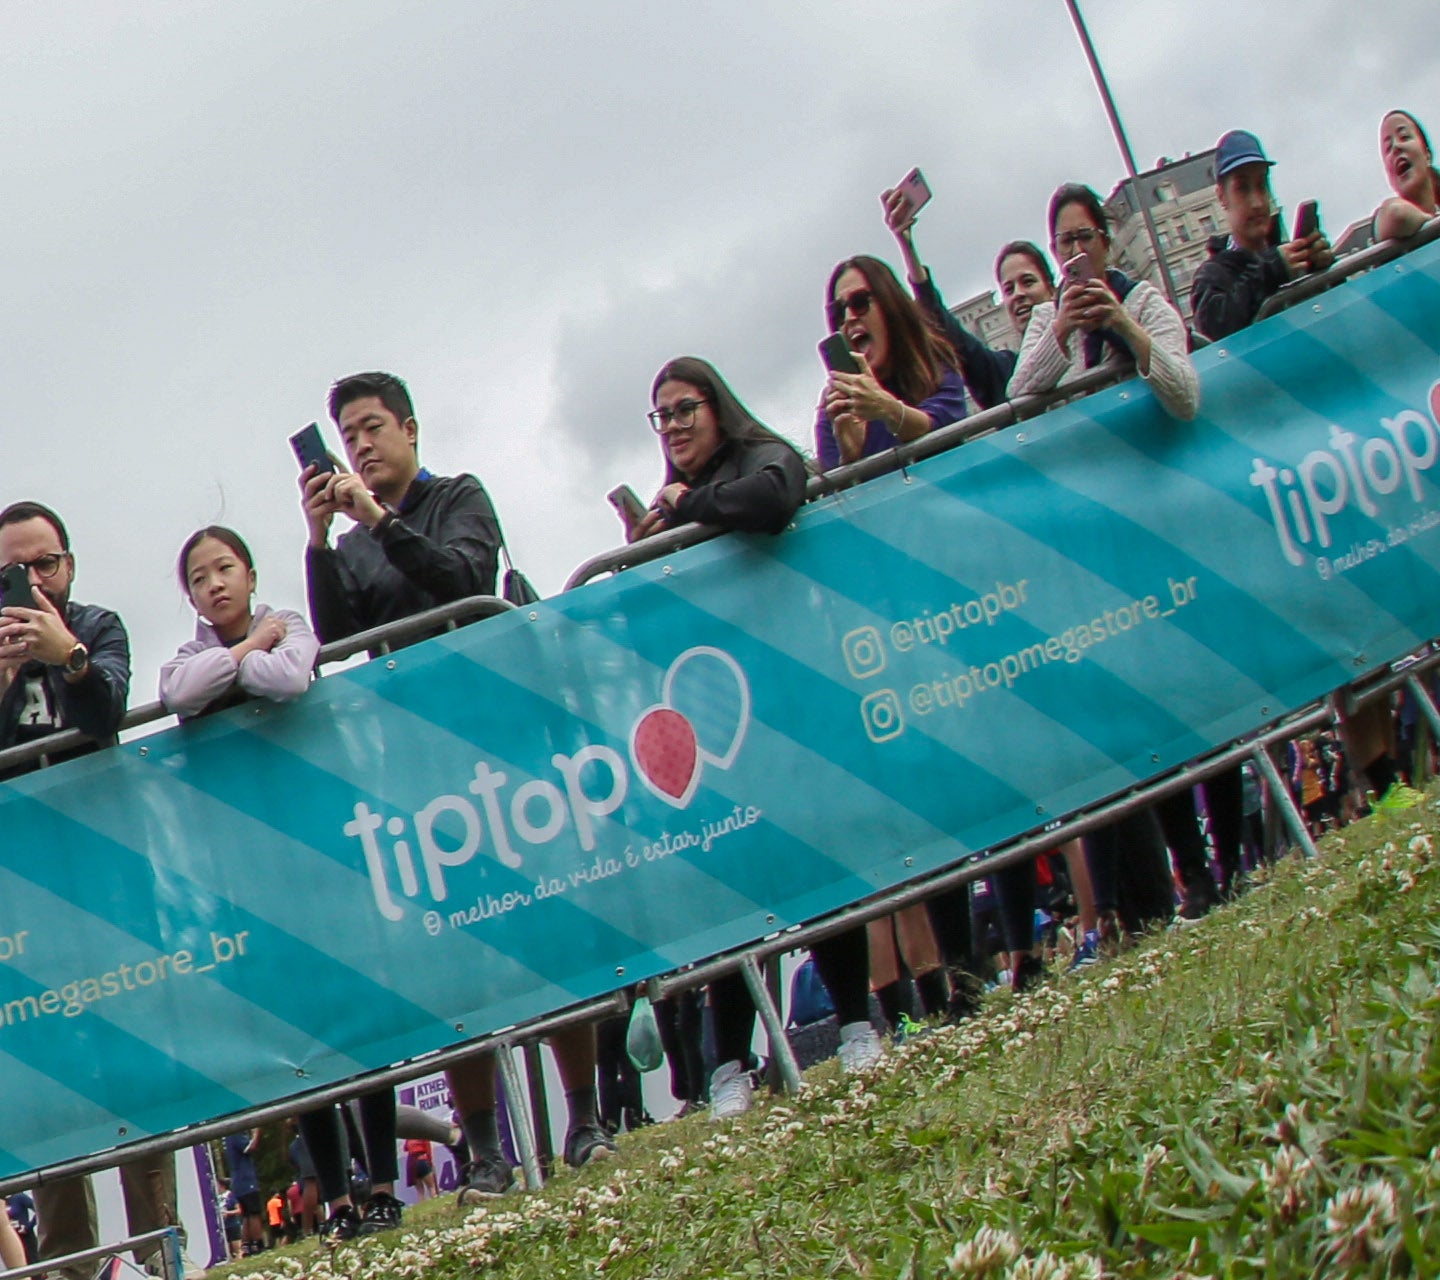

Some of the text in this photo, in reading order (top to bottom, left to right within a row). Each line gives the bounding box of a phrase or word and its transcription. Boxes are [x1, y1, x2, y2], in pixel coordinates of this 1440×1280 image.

[1250, 408, 1438, 568] tiptop
[889, 576, 1030, 653] @tiptopbr
[909, 574, 1199, 717] @tiptopmegastore_br
[343, 744, 628, 921] tiptop
[449, 888, 532, 929] melhor
[534, 872, 566, 901] da
[567, 856, 622, 888] vida
[623, 844, 640, 868] é
[643, 827, 701, 862] estar
[699, 805, 762, 852] junto
[417, 1078, 447, 1098] ATHE
